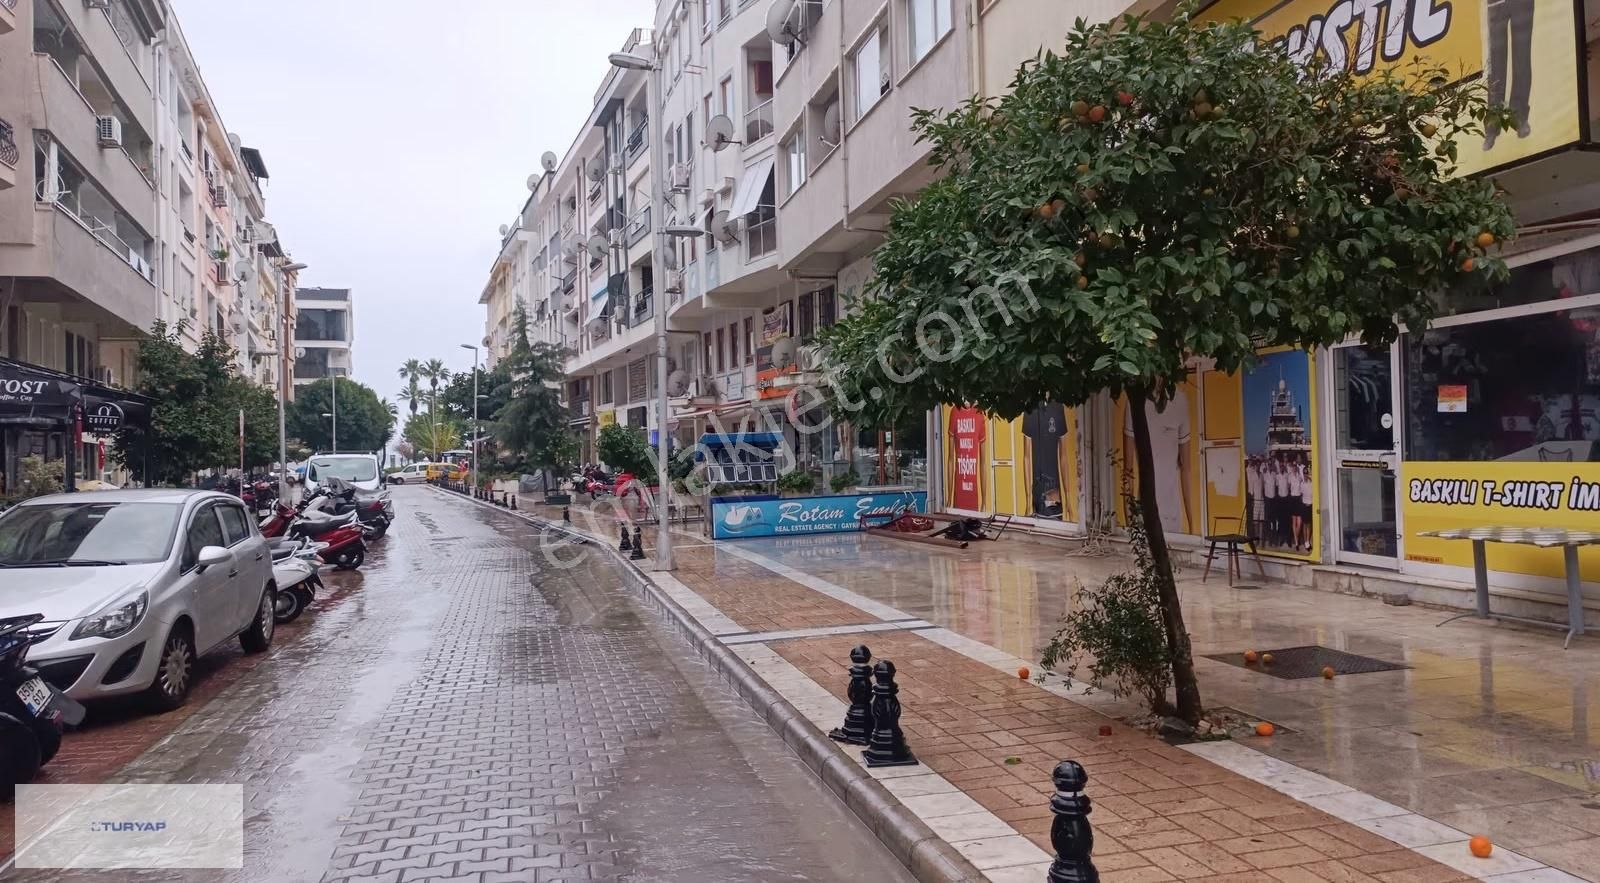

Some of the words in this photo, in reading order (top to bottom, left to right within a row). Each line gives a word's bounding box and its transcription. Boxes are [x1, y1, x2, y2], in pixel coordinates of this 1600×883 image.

[957, 418, 975, 433] BASKILI
[1410, 479, 1478, 506] BASKILI
[1482, 480, 1564, 509] T-SHIRT
[1568, 476, 1600, 509] İM
[778, 502, 844, 524] Rotam
[790, 524, 813, 532] ESTATE
[813, 523, 837, 531] AGENCY
[32, 689, 46, 706] 612
